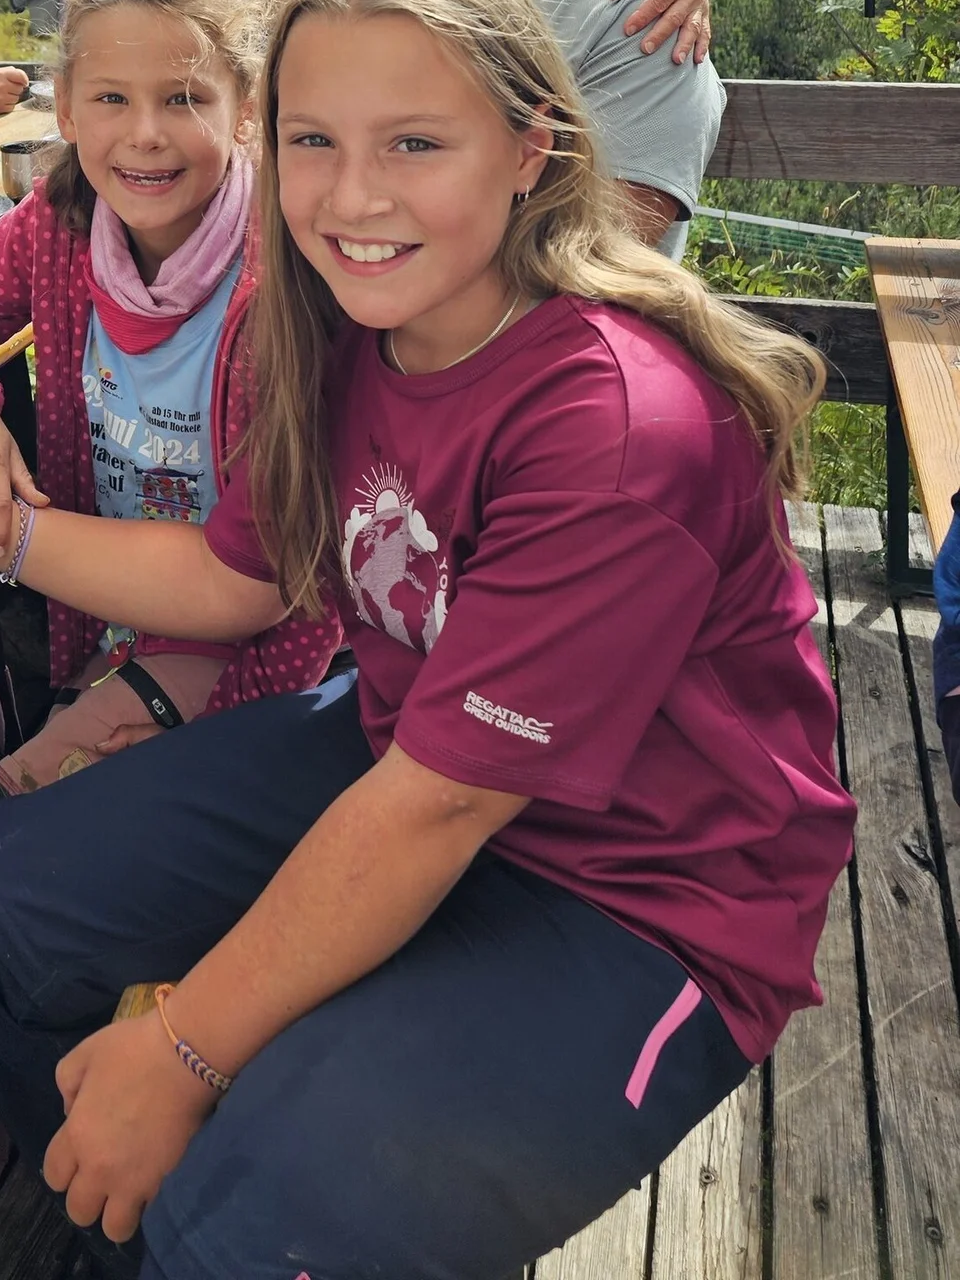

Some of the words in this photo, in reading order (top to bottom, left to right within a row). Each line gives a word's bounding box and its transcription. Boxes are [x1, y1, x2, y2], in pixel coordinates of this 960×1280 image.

[138, 428, 200, 465] 2024
[463, 701, 495, 724] GREAT
[495, 718, 551, 744] OUTDOORS
[466, 691, 524, 727] REGATTA
